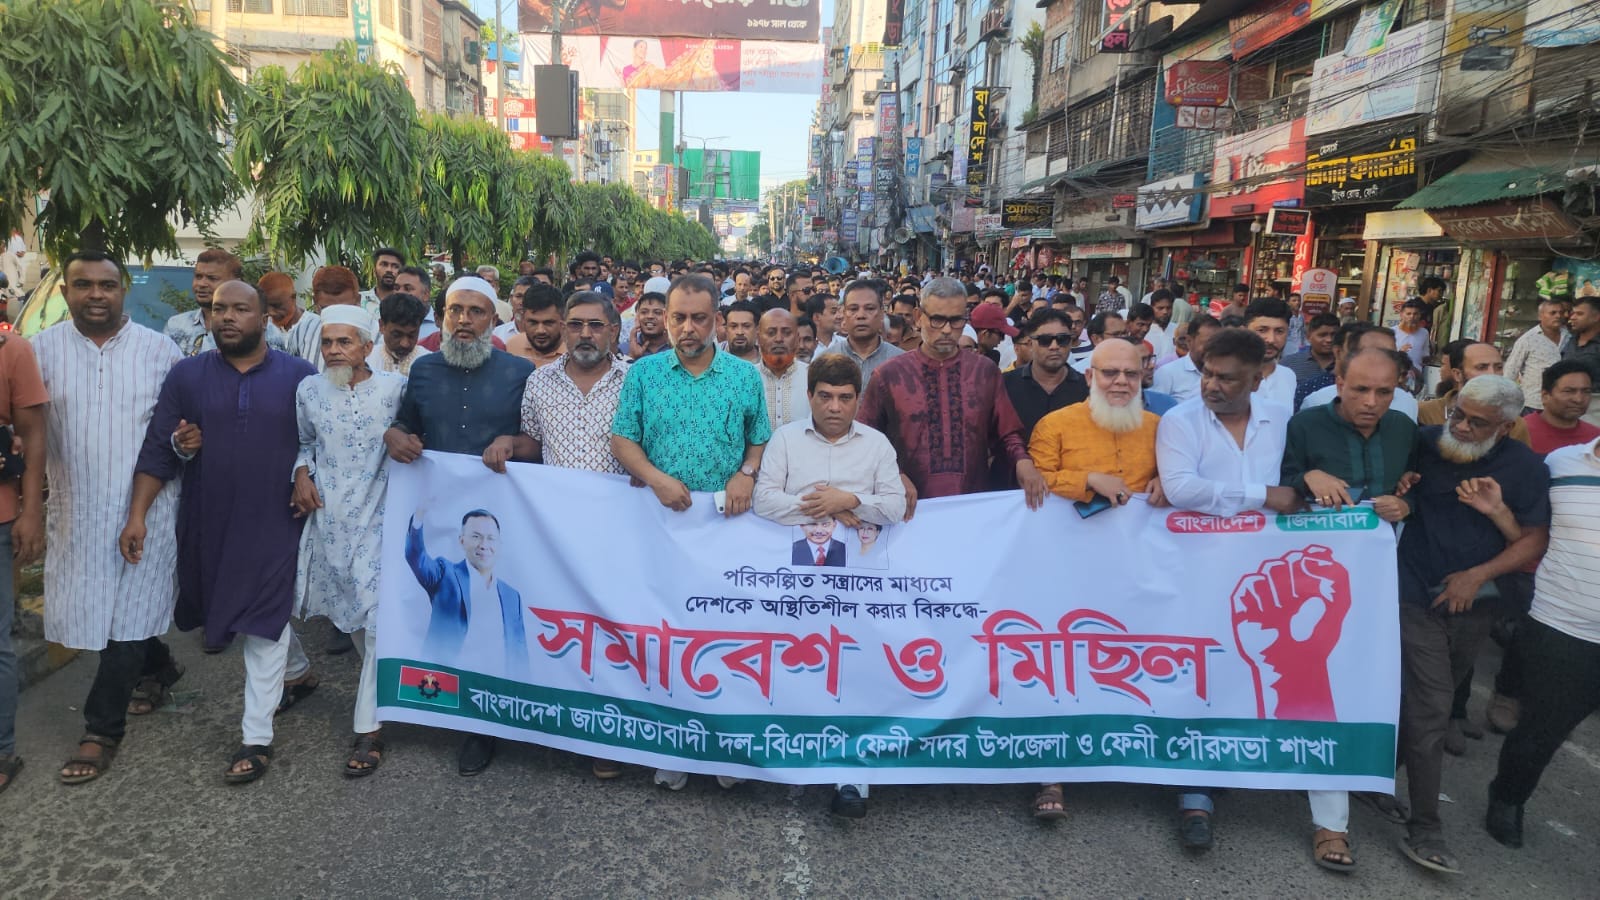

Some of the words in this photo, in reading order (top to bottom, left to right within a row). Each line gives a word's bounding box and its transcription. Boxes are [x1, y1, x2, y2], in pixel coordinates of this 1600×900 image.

[771, 18, 787, 29] সাল
[788, 18, 808, 29] থেকে
[970, 90, 989, 165] বাংলাদেশ
[1306, 153, 1348, 189] মিনার
[1173, 513, 1261, 531] বাংলাদেশ
[723, 566, 816, 590] পরিকল্পিত
[821, 572, 883, 593] সন্ত্রাসের
[888, 576, 953, 593] মাধ্যমে
[685, 595, 753, 614] দেশকে
[761, 594, 859, 621] অস্থিতিশীল
[866, 603, 907, 620] করার
[527, 606, 860, 703] সমাবেশ
[883, 637, 947, 698] ও
[971, 608, 1224, 708] মিছিল
[469, 687, 565, 728] বাংলাদেশ
[568, 703, 711, 753] জাতীয়তাবাদী
[856, 725, 913, 758] ফেনী
[919, 733, 969, 760] সদর
[977, 726, 1069, 761] উপজেলা
[1077, 735, 1093, 756] ও
[1101, 723, 1159, 758] ফেনী
[1166, 727, 1269, 764] পৌরসভা
[1278, 735, 1338, 767] শাখা
